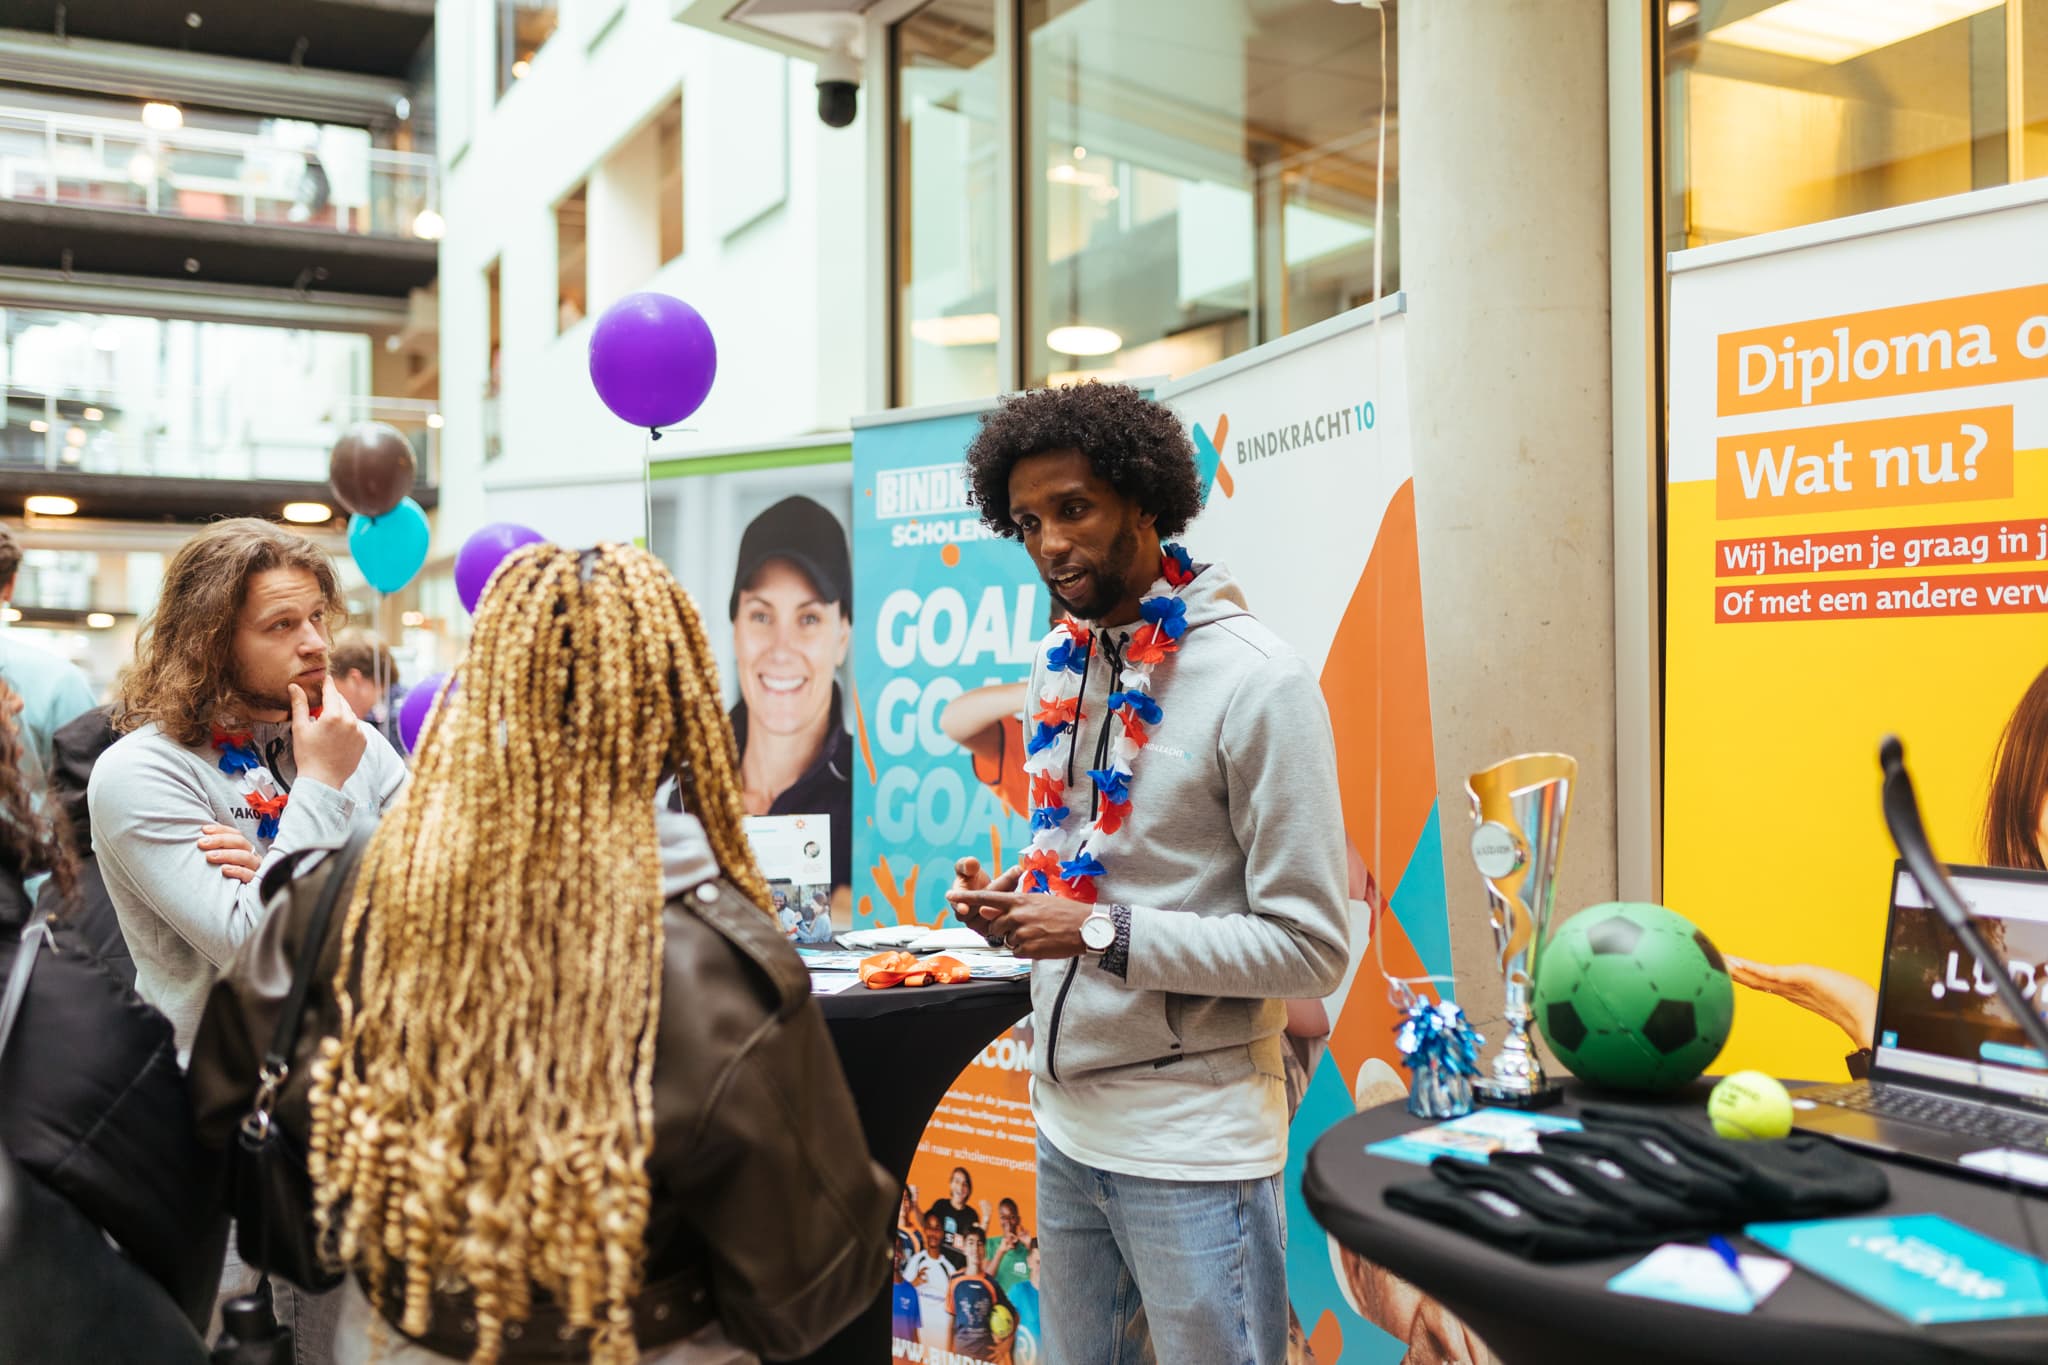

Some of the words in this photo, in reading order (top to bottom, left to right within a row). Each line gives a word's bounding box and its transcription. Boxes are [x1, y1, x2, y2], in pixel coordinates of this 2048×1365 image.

[1738, 324, 1998, 405] Diploma
[1236, 400, 1376, 465] BINDKRACHT10
[1735, 438, 1853, 500] Wat
[1869, 423, 1989, 489] nu?
[1723, 542, 1766, 576] Wij
[1772, 538, 1863, 573] helpen
[1868, 534, 1896, 569] je
[1903, 534, 1989, 568] graag
[1998, 526, 2028, 554] in
[1723, 589, 1755, 616] Of
[1759, 588, 1812, 615] met
[1818, 590, 1868, 613] een
[1875, 581, 1978, 610] andere
